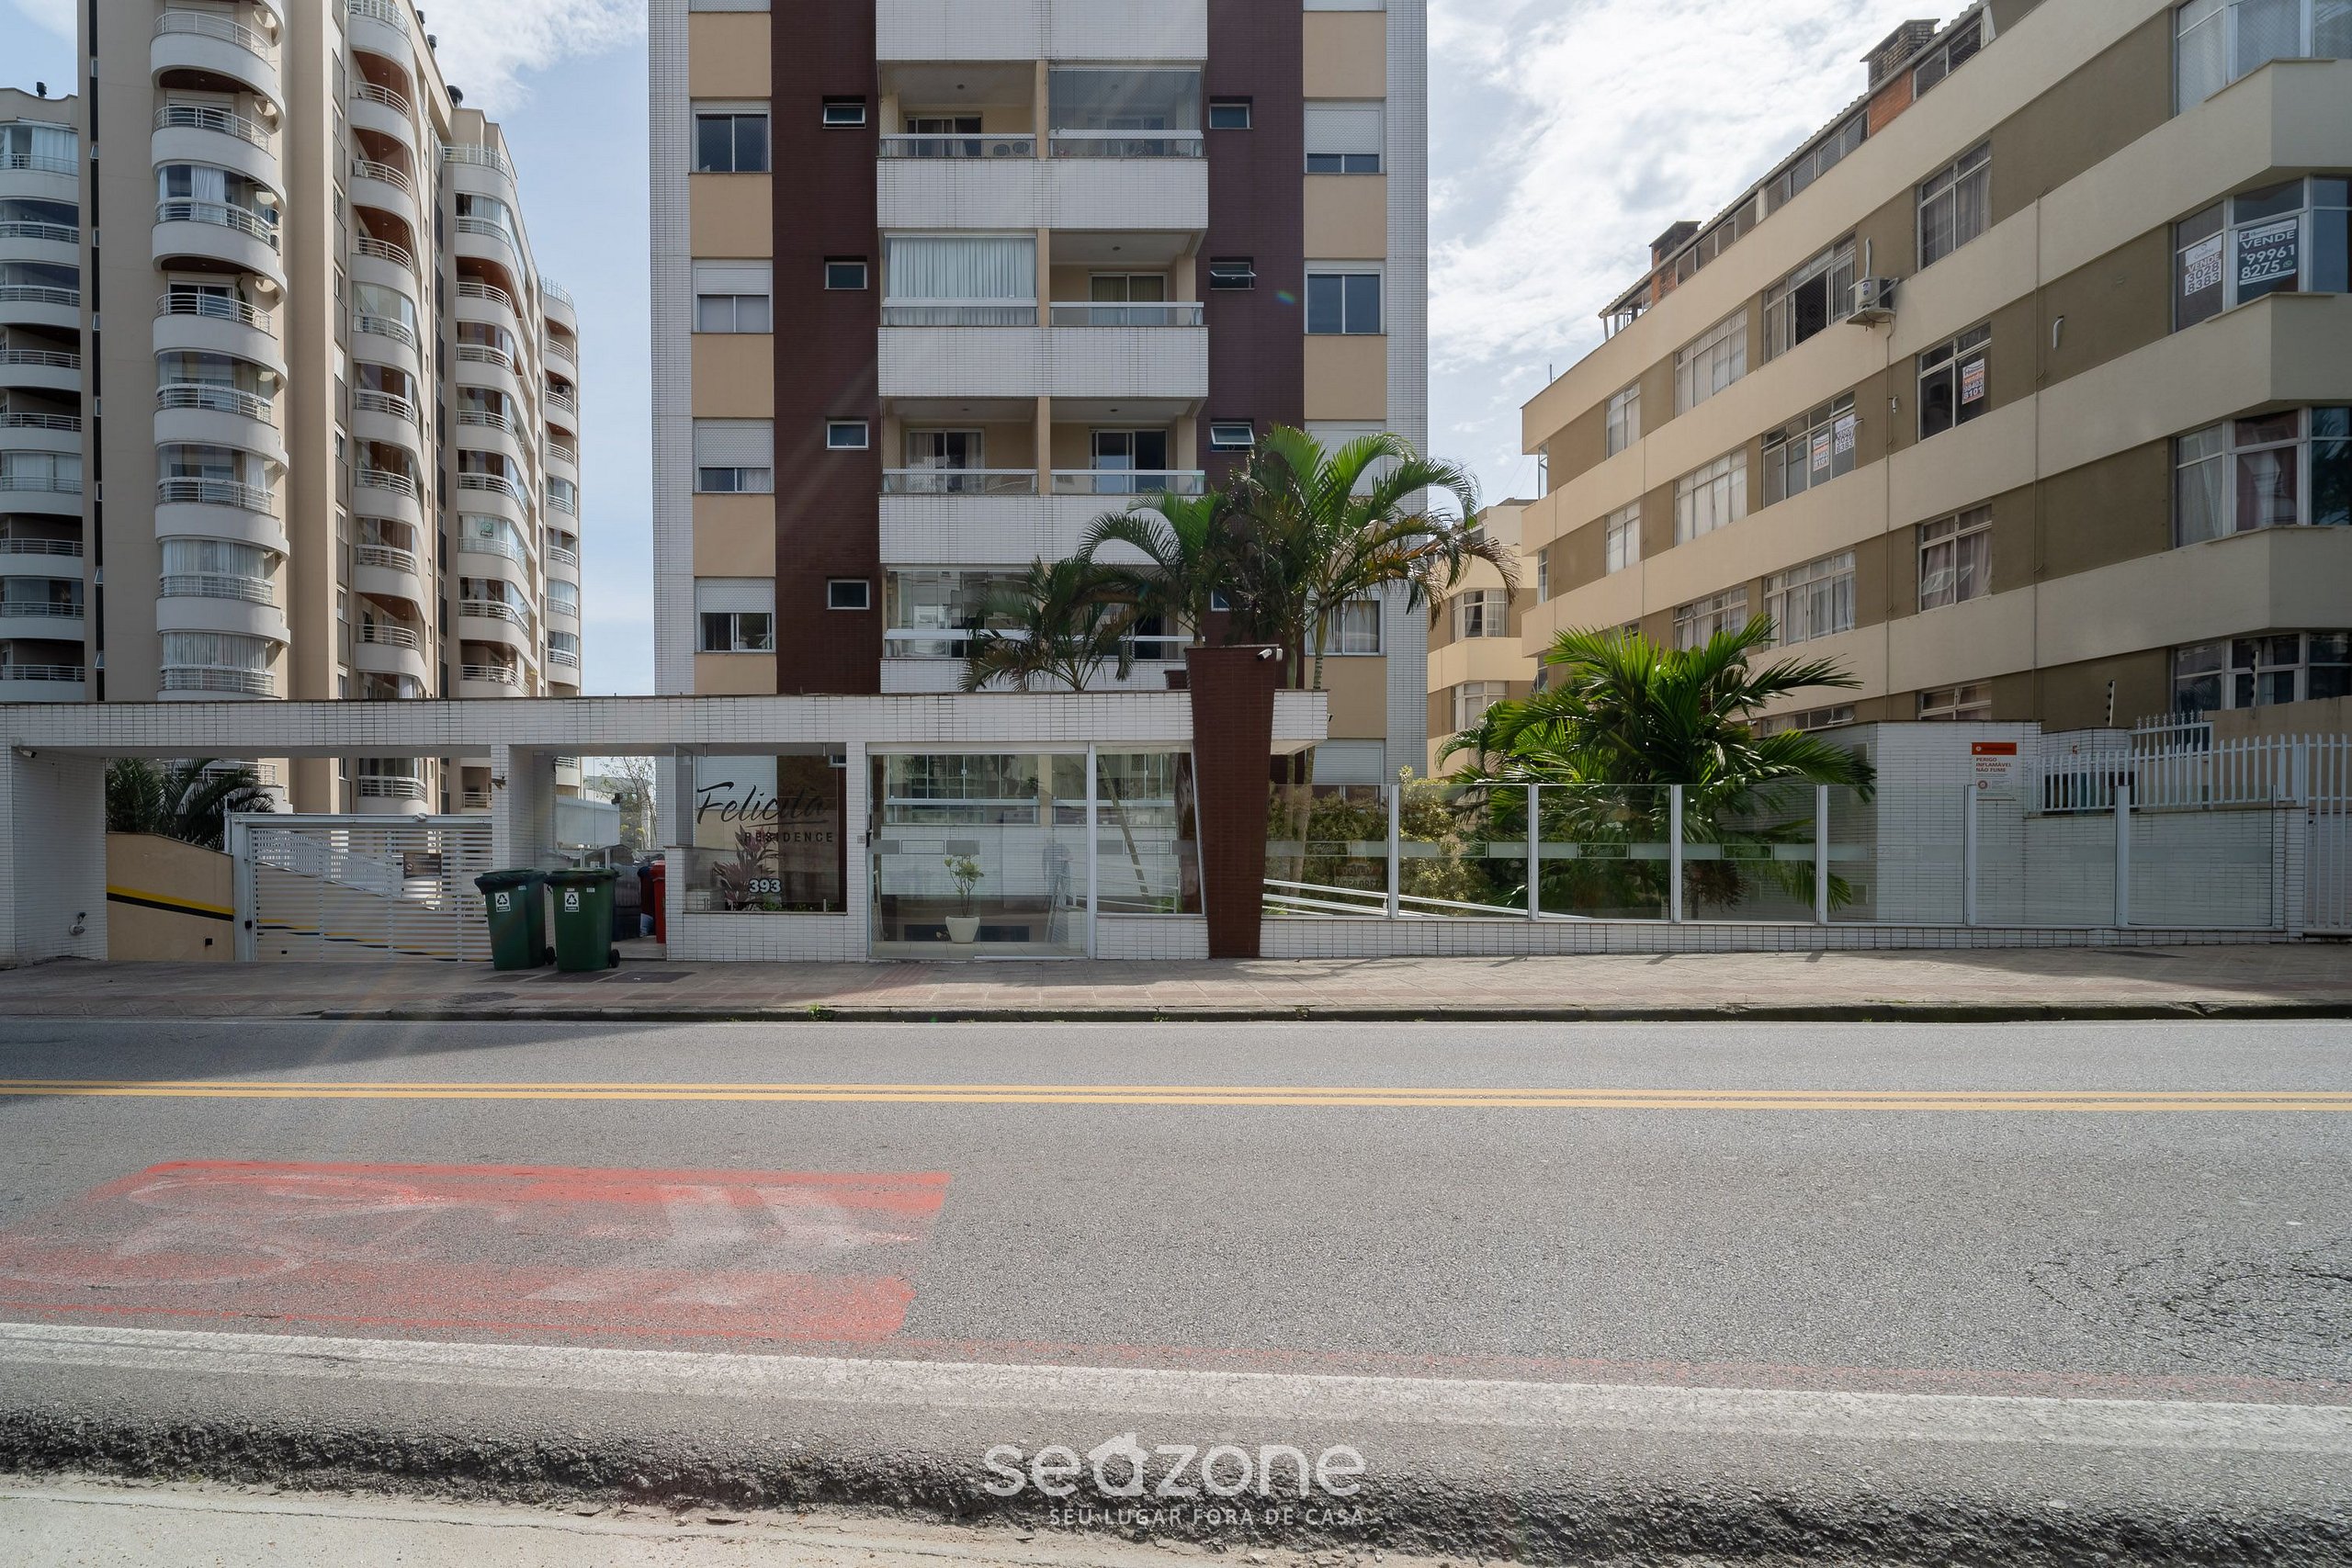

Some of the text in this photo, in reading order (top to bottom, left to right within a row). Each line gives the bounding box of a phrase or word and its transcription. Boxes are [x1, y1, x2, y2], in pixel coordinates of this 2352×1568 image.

[2242, 230, 2295, 249] VENDE
[2188, 252, 2221, 273] VENDE
[2246, 243, 2295, 265] 99961
[2188, 262, 2220, 283] 3028
[2242, 260, 2280, 279] 8275
[2188, 271, 2220, 293] 8383
[743, 831, 833, 843] RESIDENCE
[749, 877, 781, 893] 393
